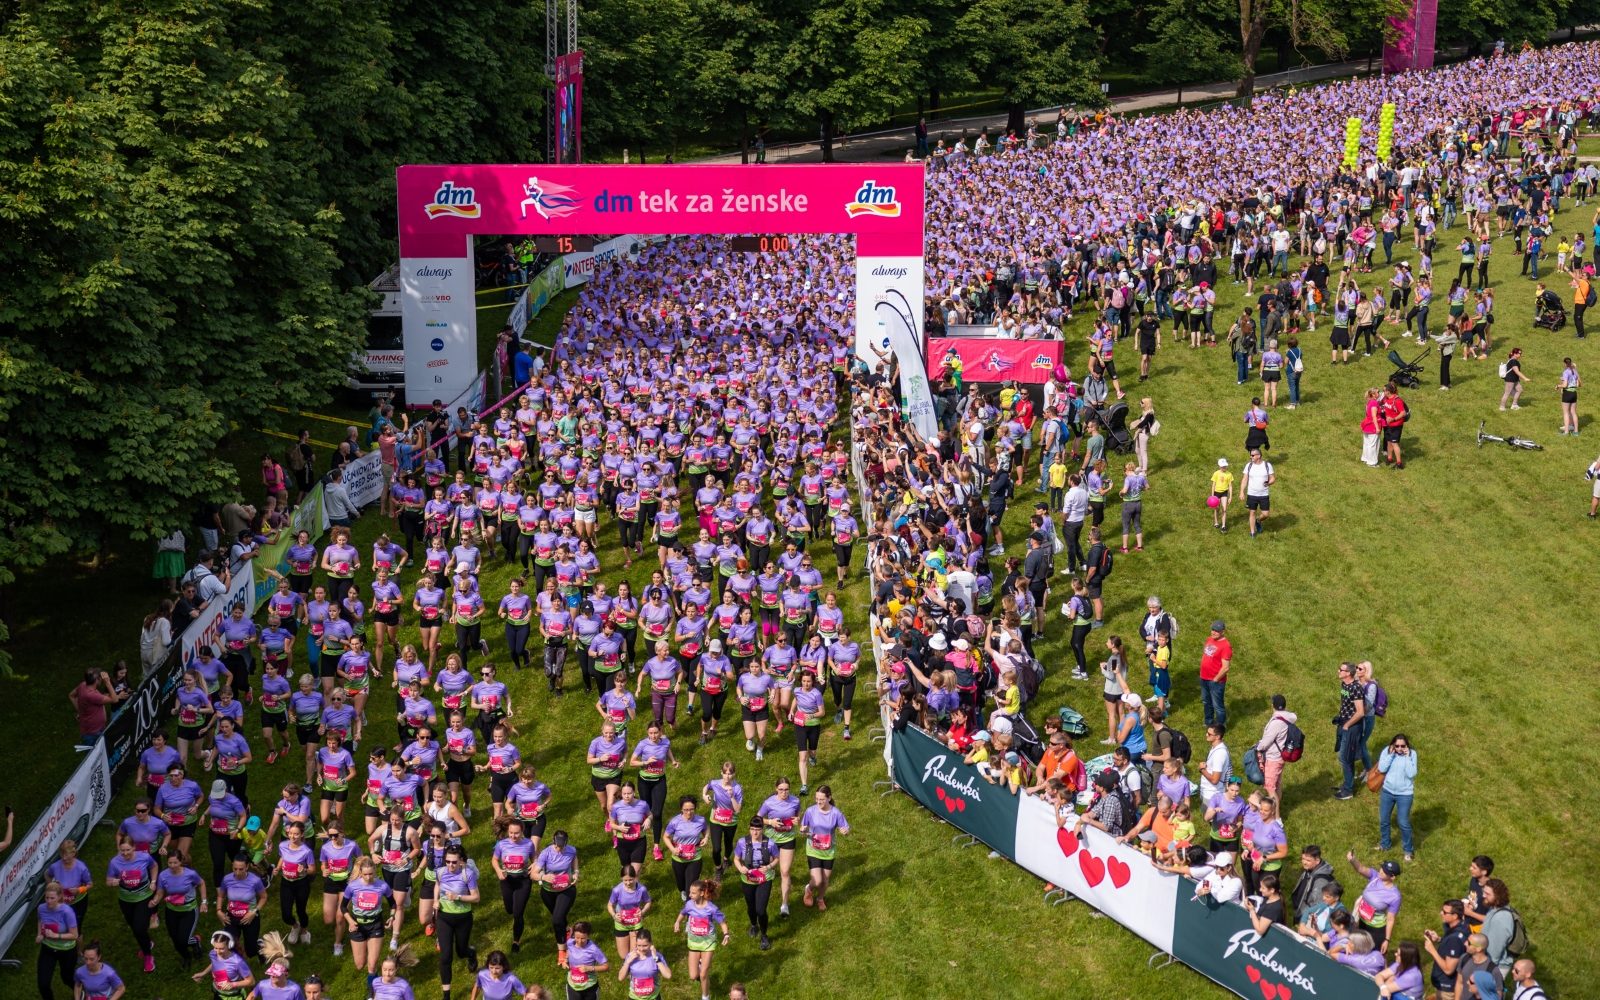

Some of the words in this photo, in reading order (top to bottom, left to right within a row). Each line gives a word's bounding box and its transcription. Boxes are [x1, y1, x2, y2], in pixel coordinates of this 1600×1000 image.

[436, 183, 473, 206] dm
[594, 189, 633, 213] dm
[639, 188, 678, 213] tek
[685, 194, 714, 213] za
[721, 188, 808, 213] ženske
[856, 182, 896, 205] dm
[416, 265, 453, 281] always
[572, 248, 616, 277] INTERSPORT
[871, 264, 908, 280] always
[366, 354, 404, 362] TIMING
[922, 754, 982, 802] Radenska
[55, 793, 75, 820] zobe
[1223, 928, 1317, 994] Radenska
